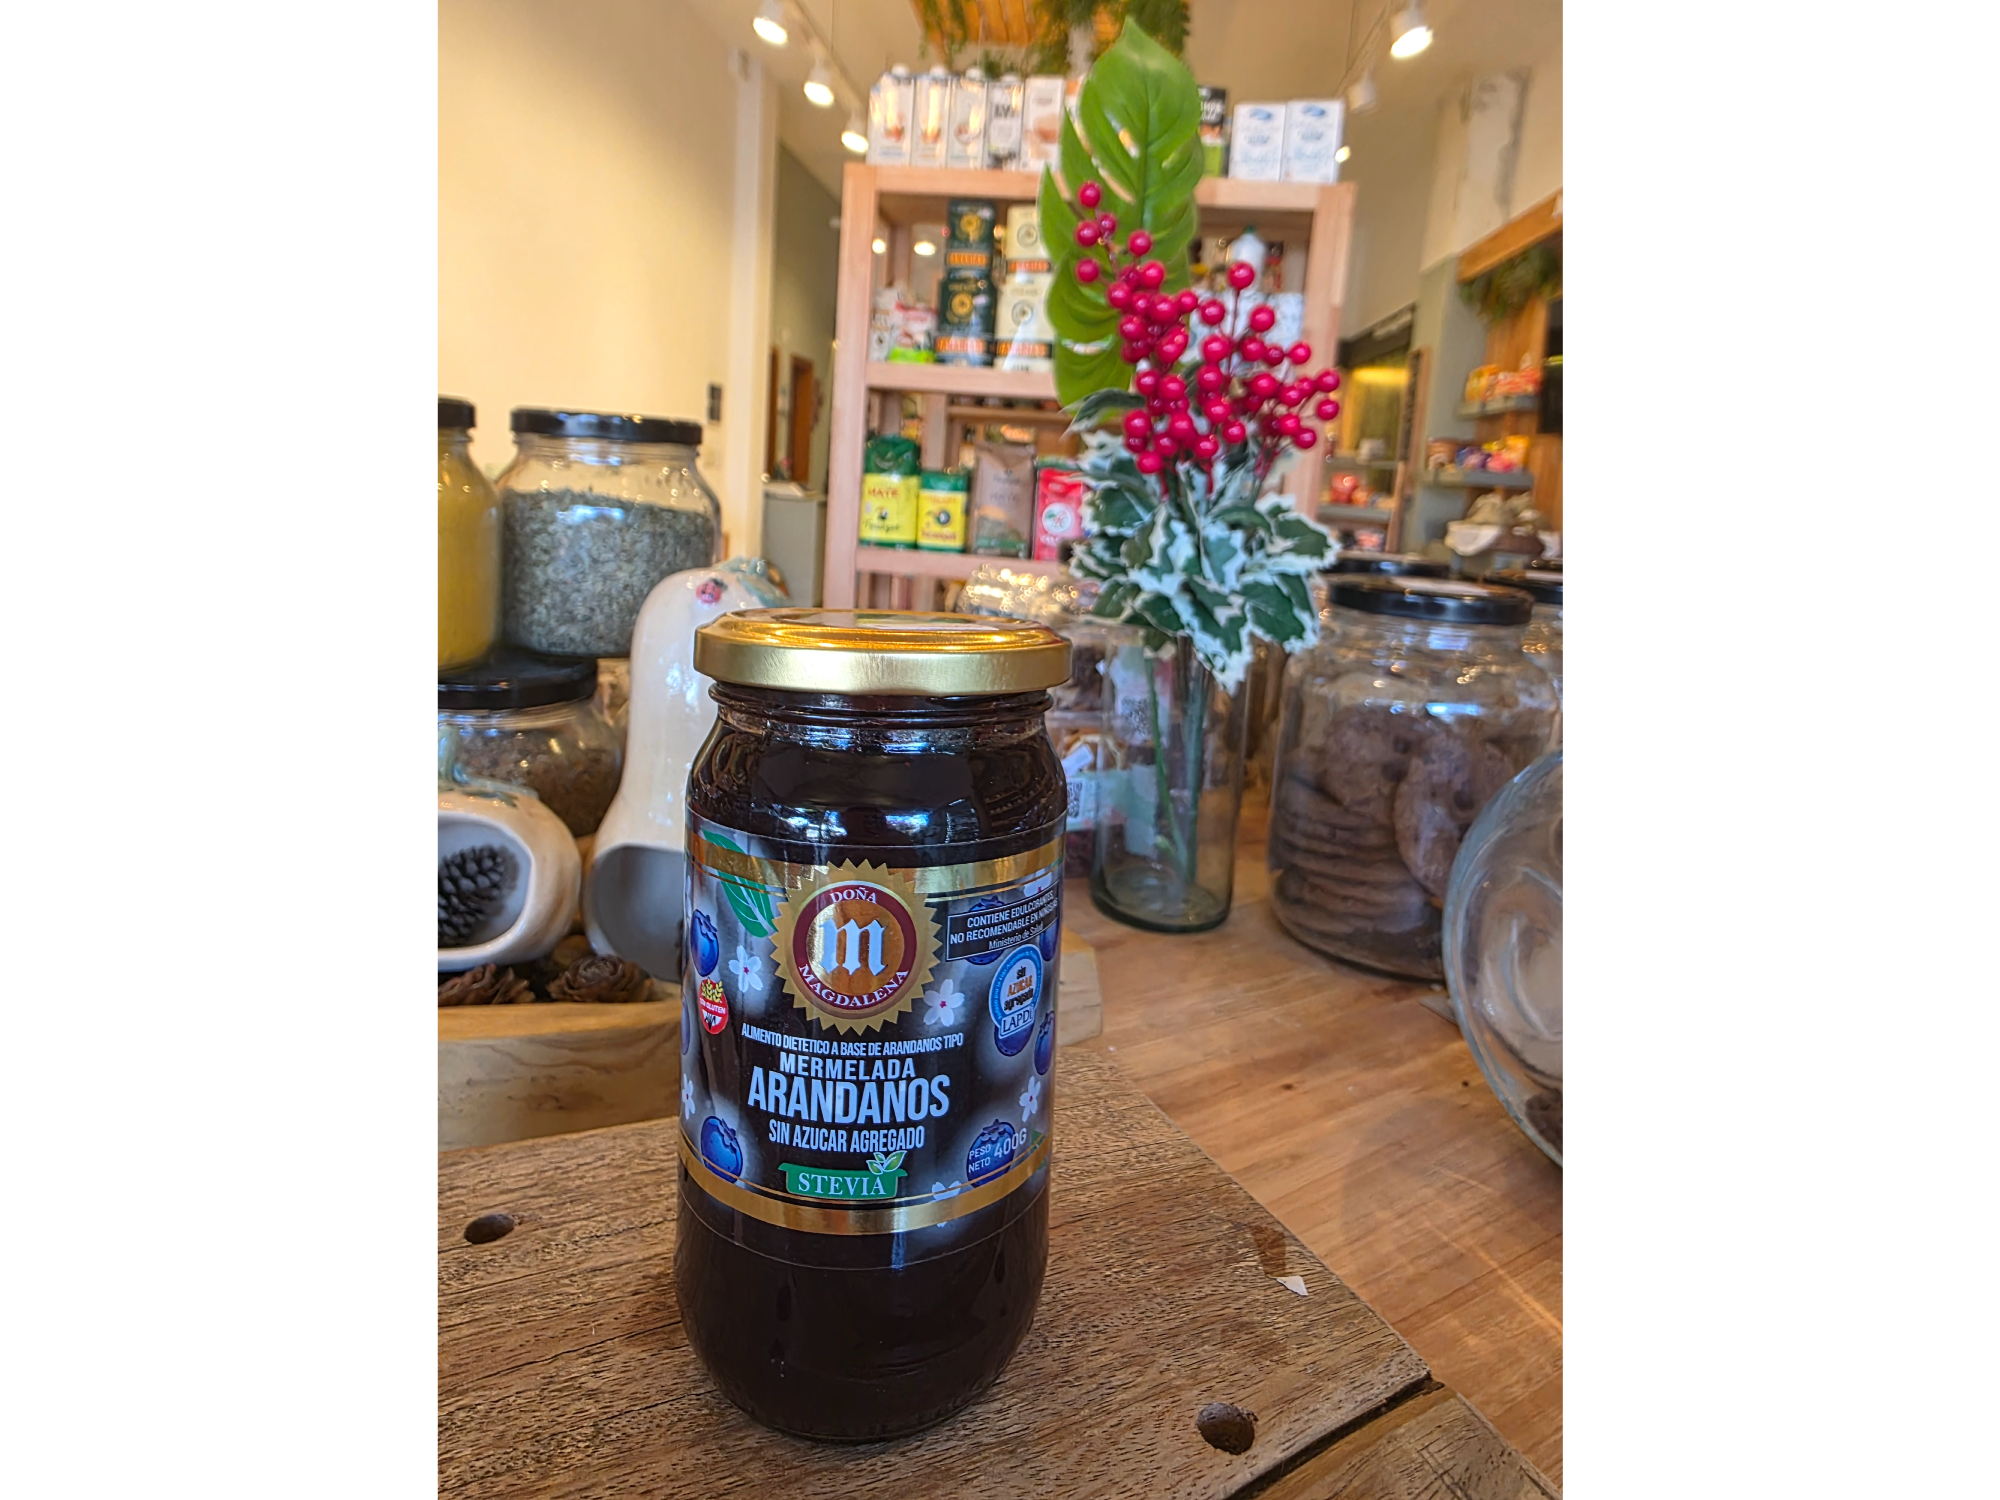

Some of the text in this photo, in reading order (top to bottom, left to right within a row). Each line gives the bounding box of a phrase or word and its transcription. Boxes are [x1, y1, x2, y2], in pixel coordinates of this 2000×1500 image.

[830, 887, 877, 904] DOÑA
[950, 933, 965, 945] NO
[966, 915, 1030, 941] RECOMENDABLE
[1030, 911, 1039, 923] EN
[967, 910, 1010, 928] CONTIENE
[989, 921, 1043, 950] Ministerio de Salud
[798, 963, 909, 1007] MAGDALENA
[1016, 966, 1027, 979] sin
[706, 1003, 726, 1014] GLUTEN
[741, 1022, 964, 1057] ALIMENTO DIETETICO A BASE DE ARANDANOS TIPO
[779, 1051, 916, 1080] MERMELADA
[747, 1065, 950, 1124] ARANDANOS
[768, 1118, 926, 1153] SIN AZUCAR AGREGADO
[993, 1127, 1027, 1158] 400G
[968, 1156, 991, 1173] NETO
[969, 1143, 991, 1160] PESO
[798, 1172, 887, 1196] STEVIA
